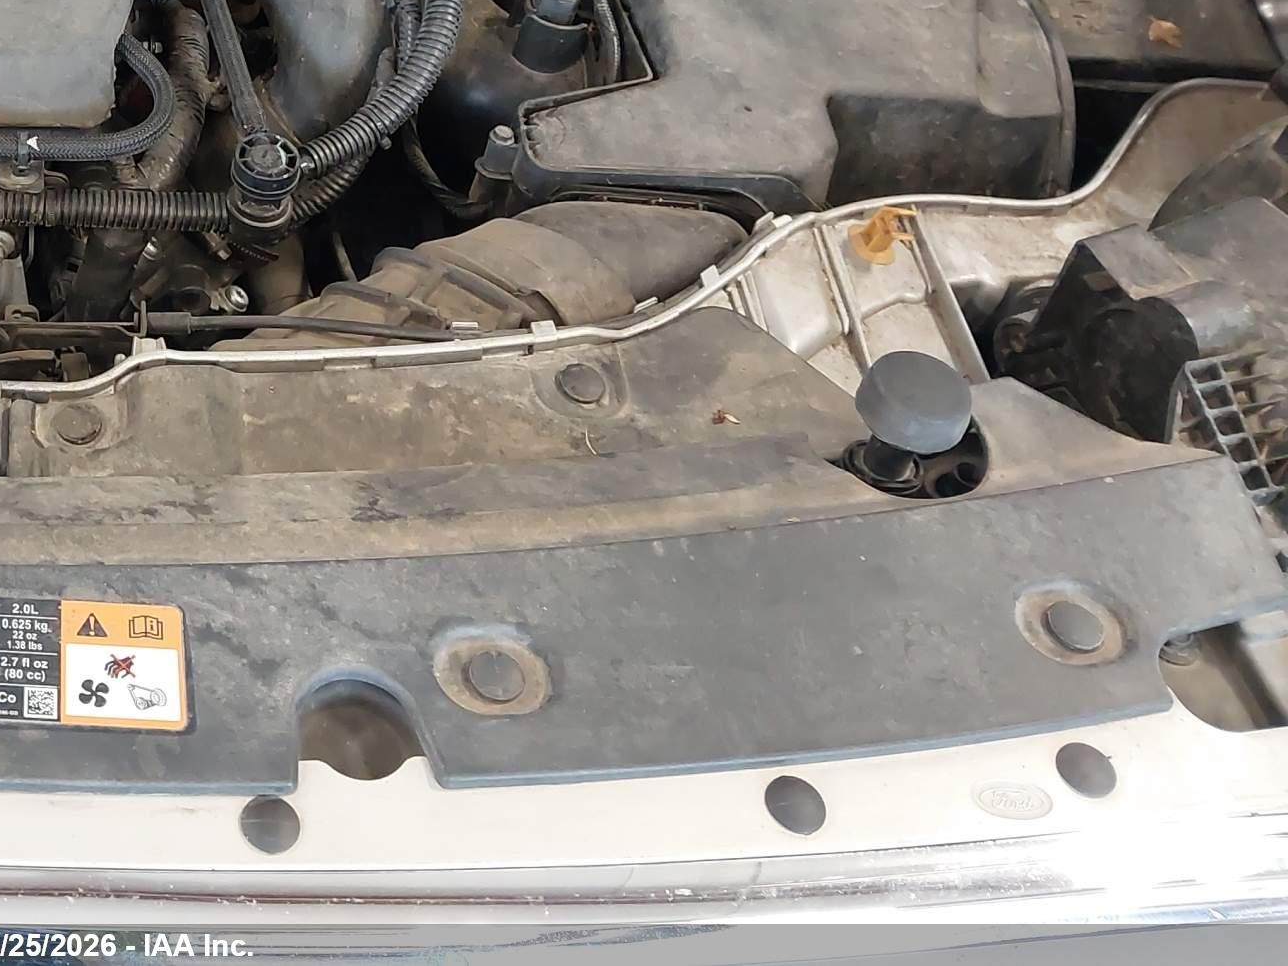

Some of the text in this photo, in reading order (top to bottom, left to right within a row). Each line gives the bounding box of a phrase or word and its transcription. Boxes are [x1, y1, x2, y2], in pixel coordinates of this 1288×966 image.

[12, 603, 39, 615] 2.0L
[2, 618, 32, 630] 0.625
[12, 631, 24, 640] 22
[6, 640, 43, 651] 1.38 lbs
[0, 656, 49, 669] 2.7 fl oz
[4, 669, 46, 682] (80 cc)
